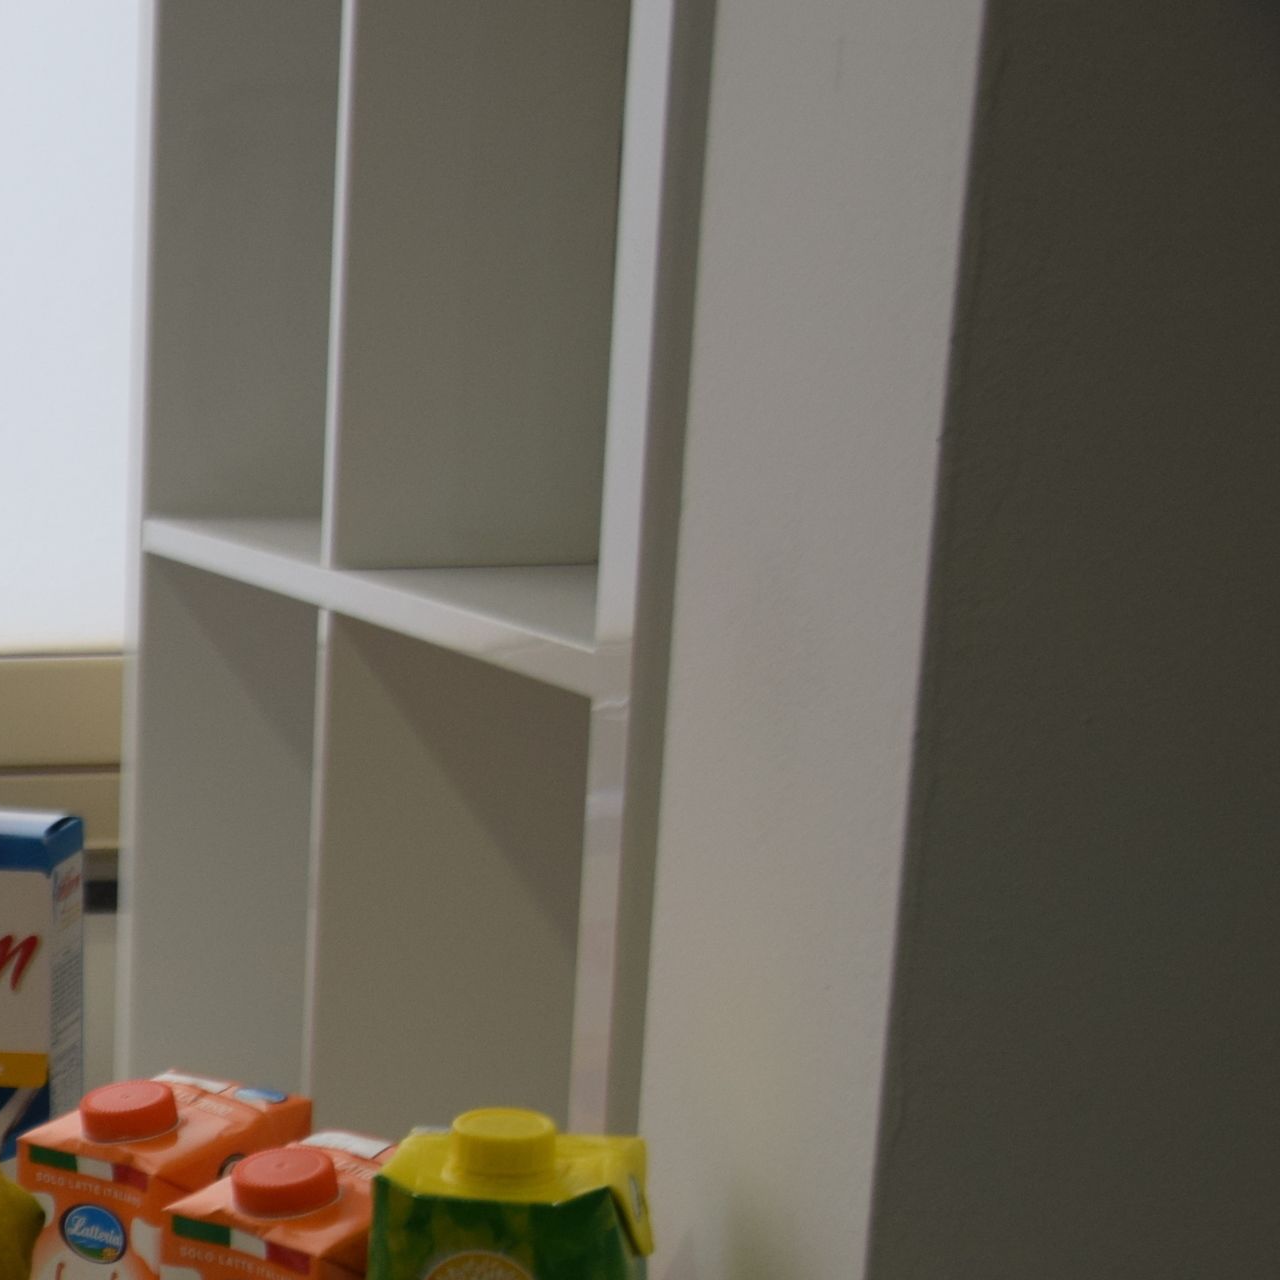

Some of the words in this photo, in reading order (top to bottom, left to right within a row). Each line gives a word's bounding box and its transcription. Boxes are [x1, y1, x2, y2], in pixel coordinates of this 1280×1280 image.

[35, 1171, 65, 1186] SOLO
[67, 1178, 102, 1195] LATTE
[179, 1247, 215, 1263] SOLO
[217, 1255, 256, 1273] LATTE
